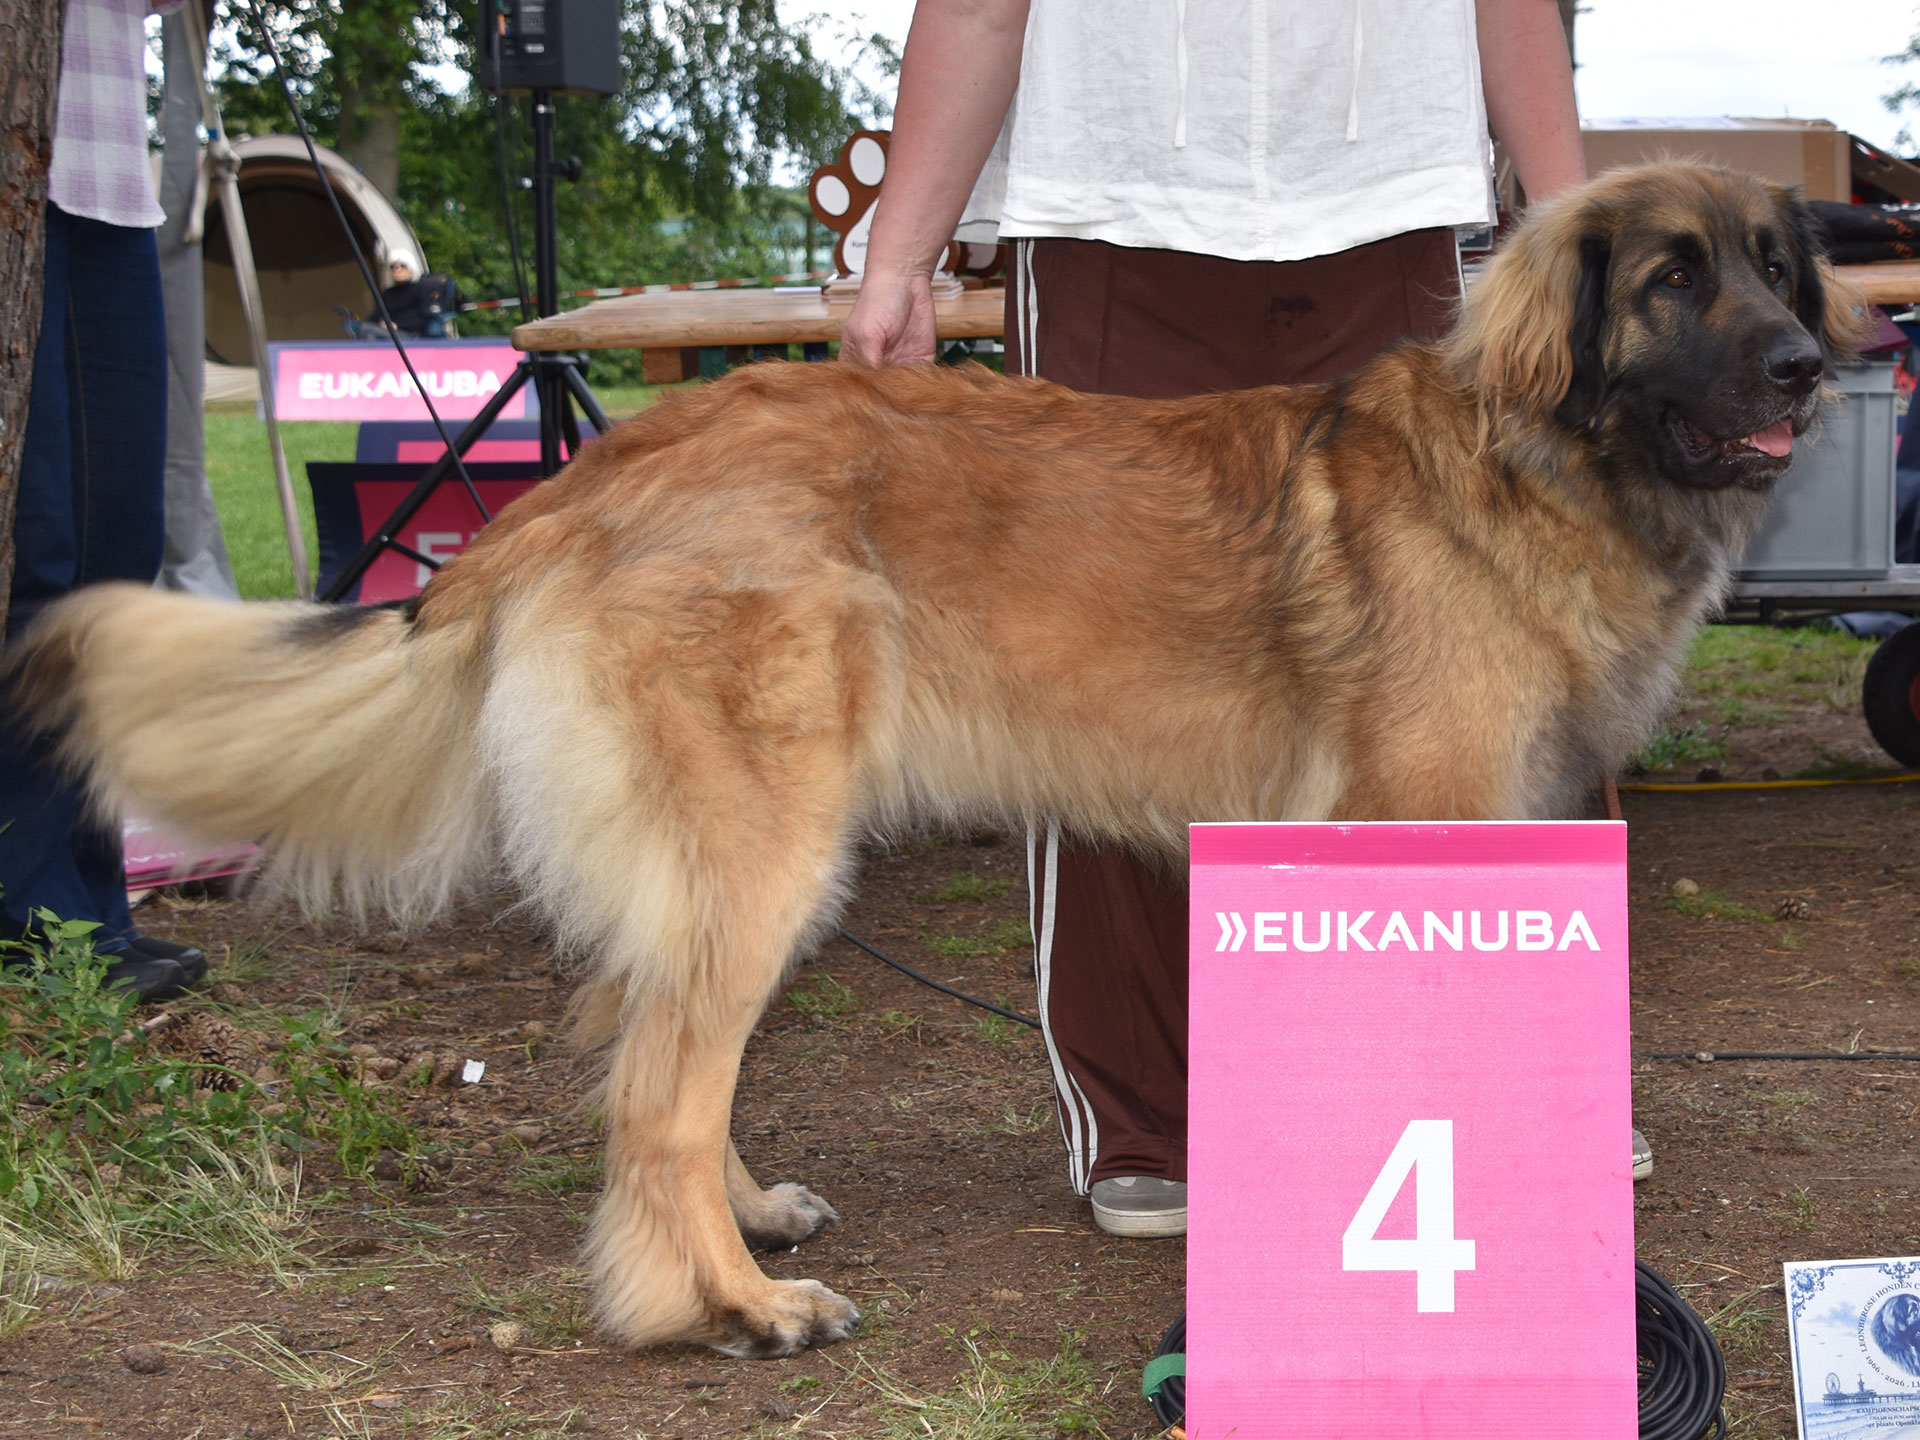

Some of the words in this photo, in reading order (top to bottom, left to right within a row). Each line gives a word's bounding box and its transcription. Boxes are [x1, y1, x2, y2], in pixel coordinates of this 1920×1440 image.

[300, 370, 501, 399] EUKANUBA
[1254, 910, 1601, 952] EUKANUBA
[1342, 1119, 1476, 1313] 4
[1875, 1281, 1912, 1298] HONDEN
